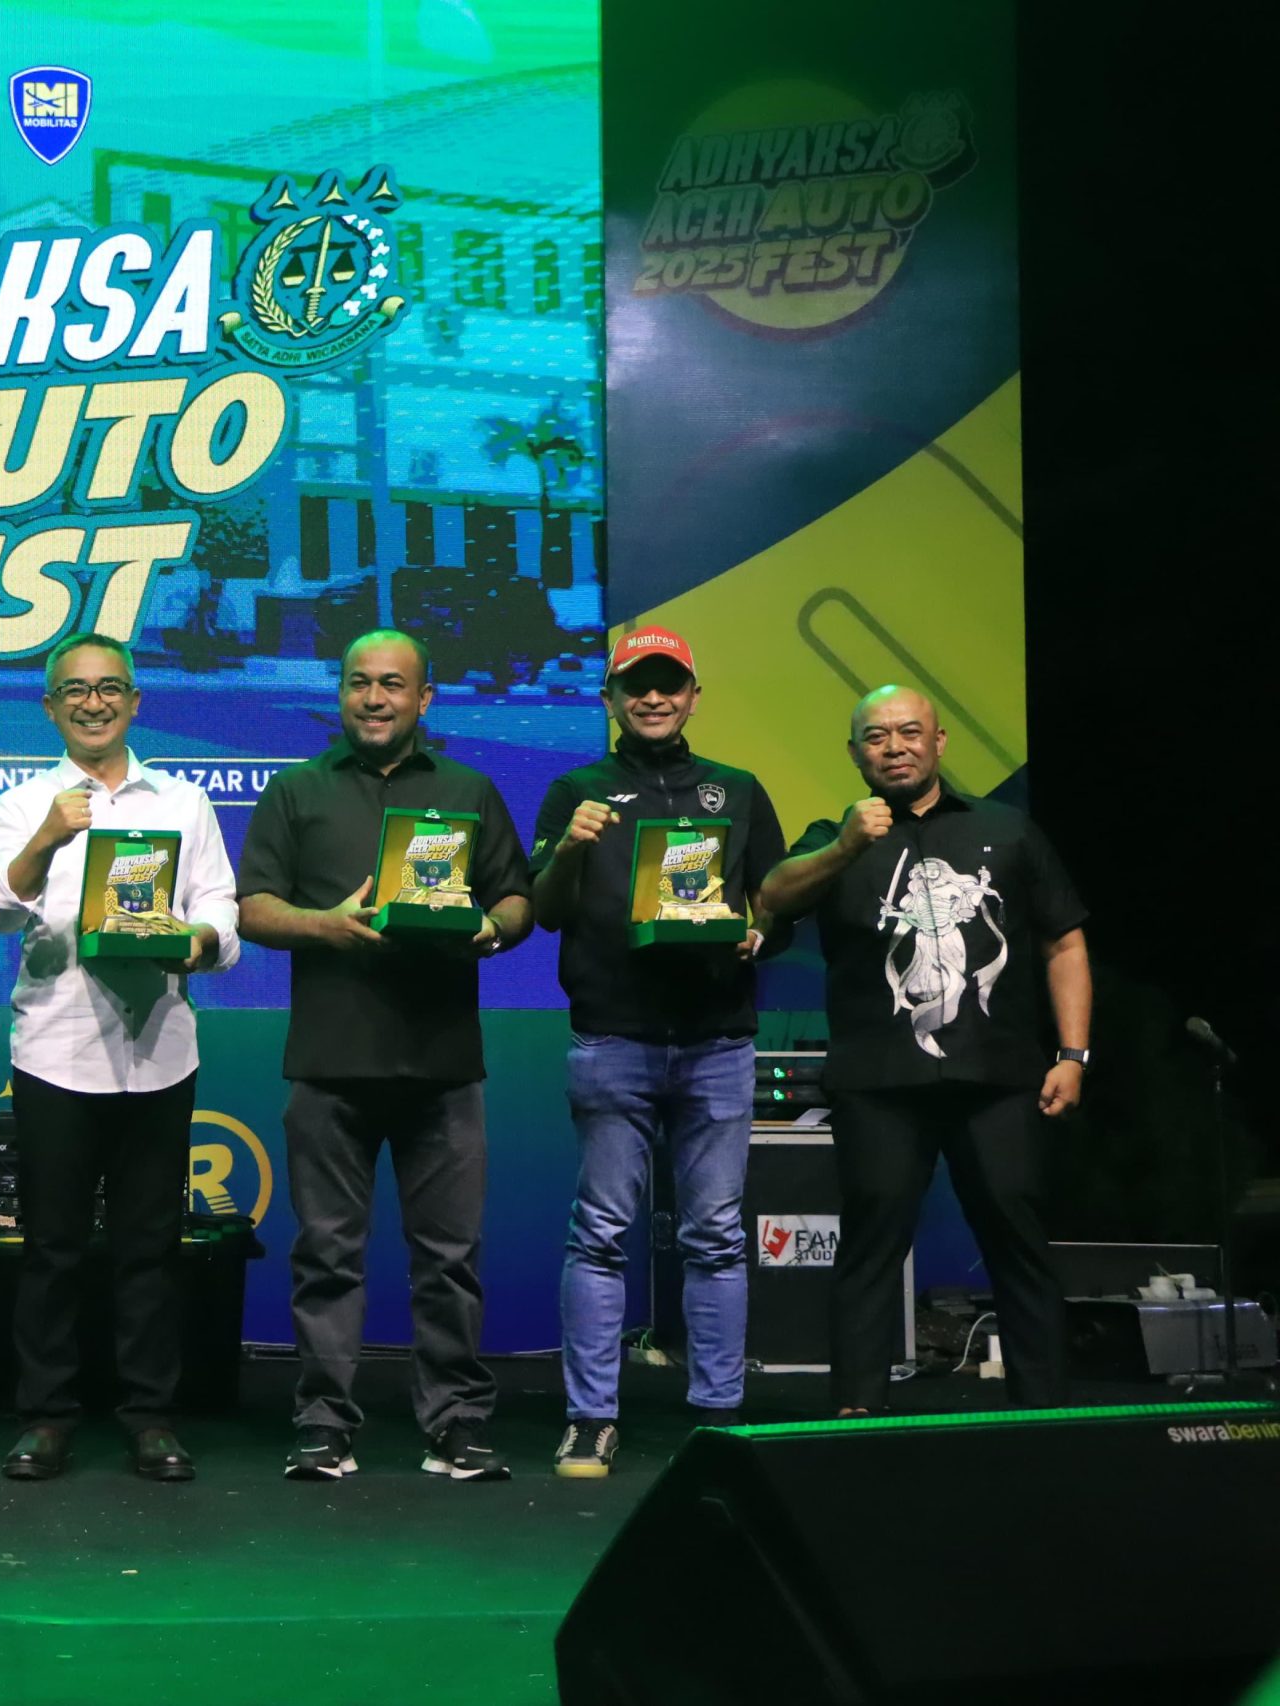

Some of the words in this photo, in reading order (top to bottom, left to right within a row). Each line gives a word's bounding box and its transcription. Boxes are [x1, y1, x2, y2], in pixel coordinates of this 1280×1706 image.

[23, 82, 79, 117] IMI
[23, 118, 78, 128] MOBILITAS
[661, 117, 899, 190] ADHYAKSA
[644, 187, 756, 248] ACEH
[757, 171, 925, 233] AUTO
[632, 249, 748, 293] 2025
[749, 230, 894, 292] FEST
[241, 331, 270, 357] SATYA
[272, 350, 301, 361] ADHI
[627, 633, 681, 650] Montreal
